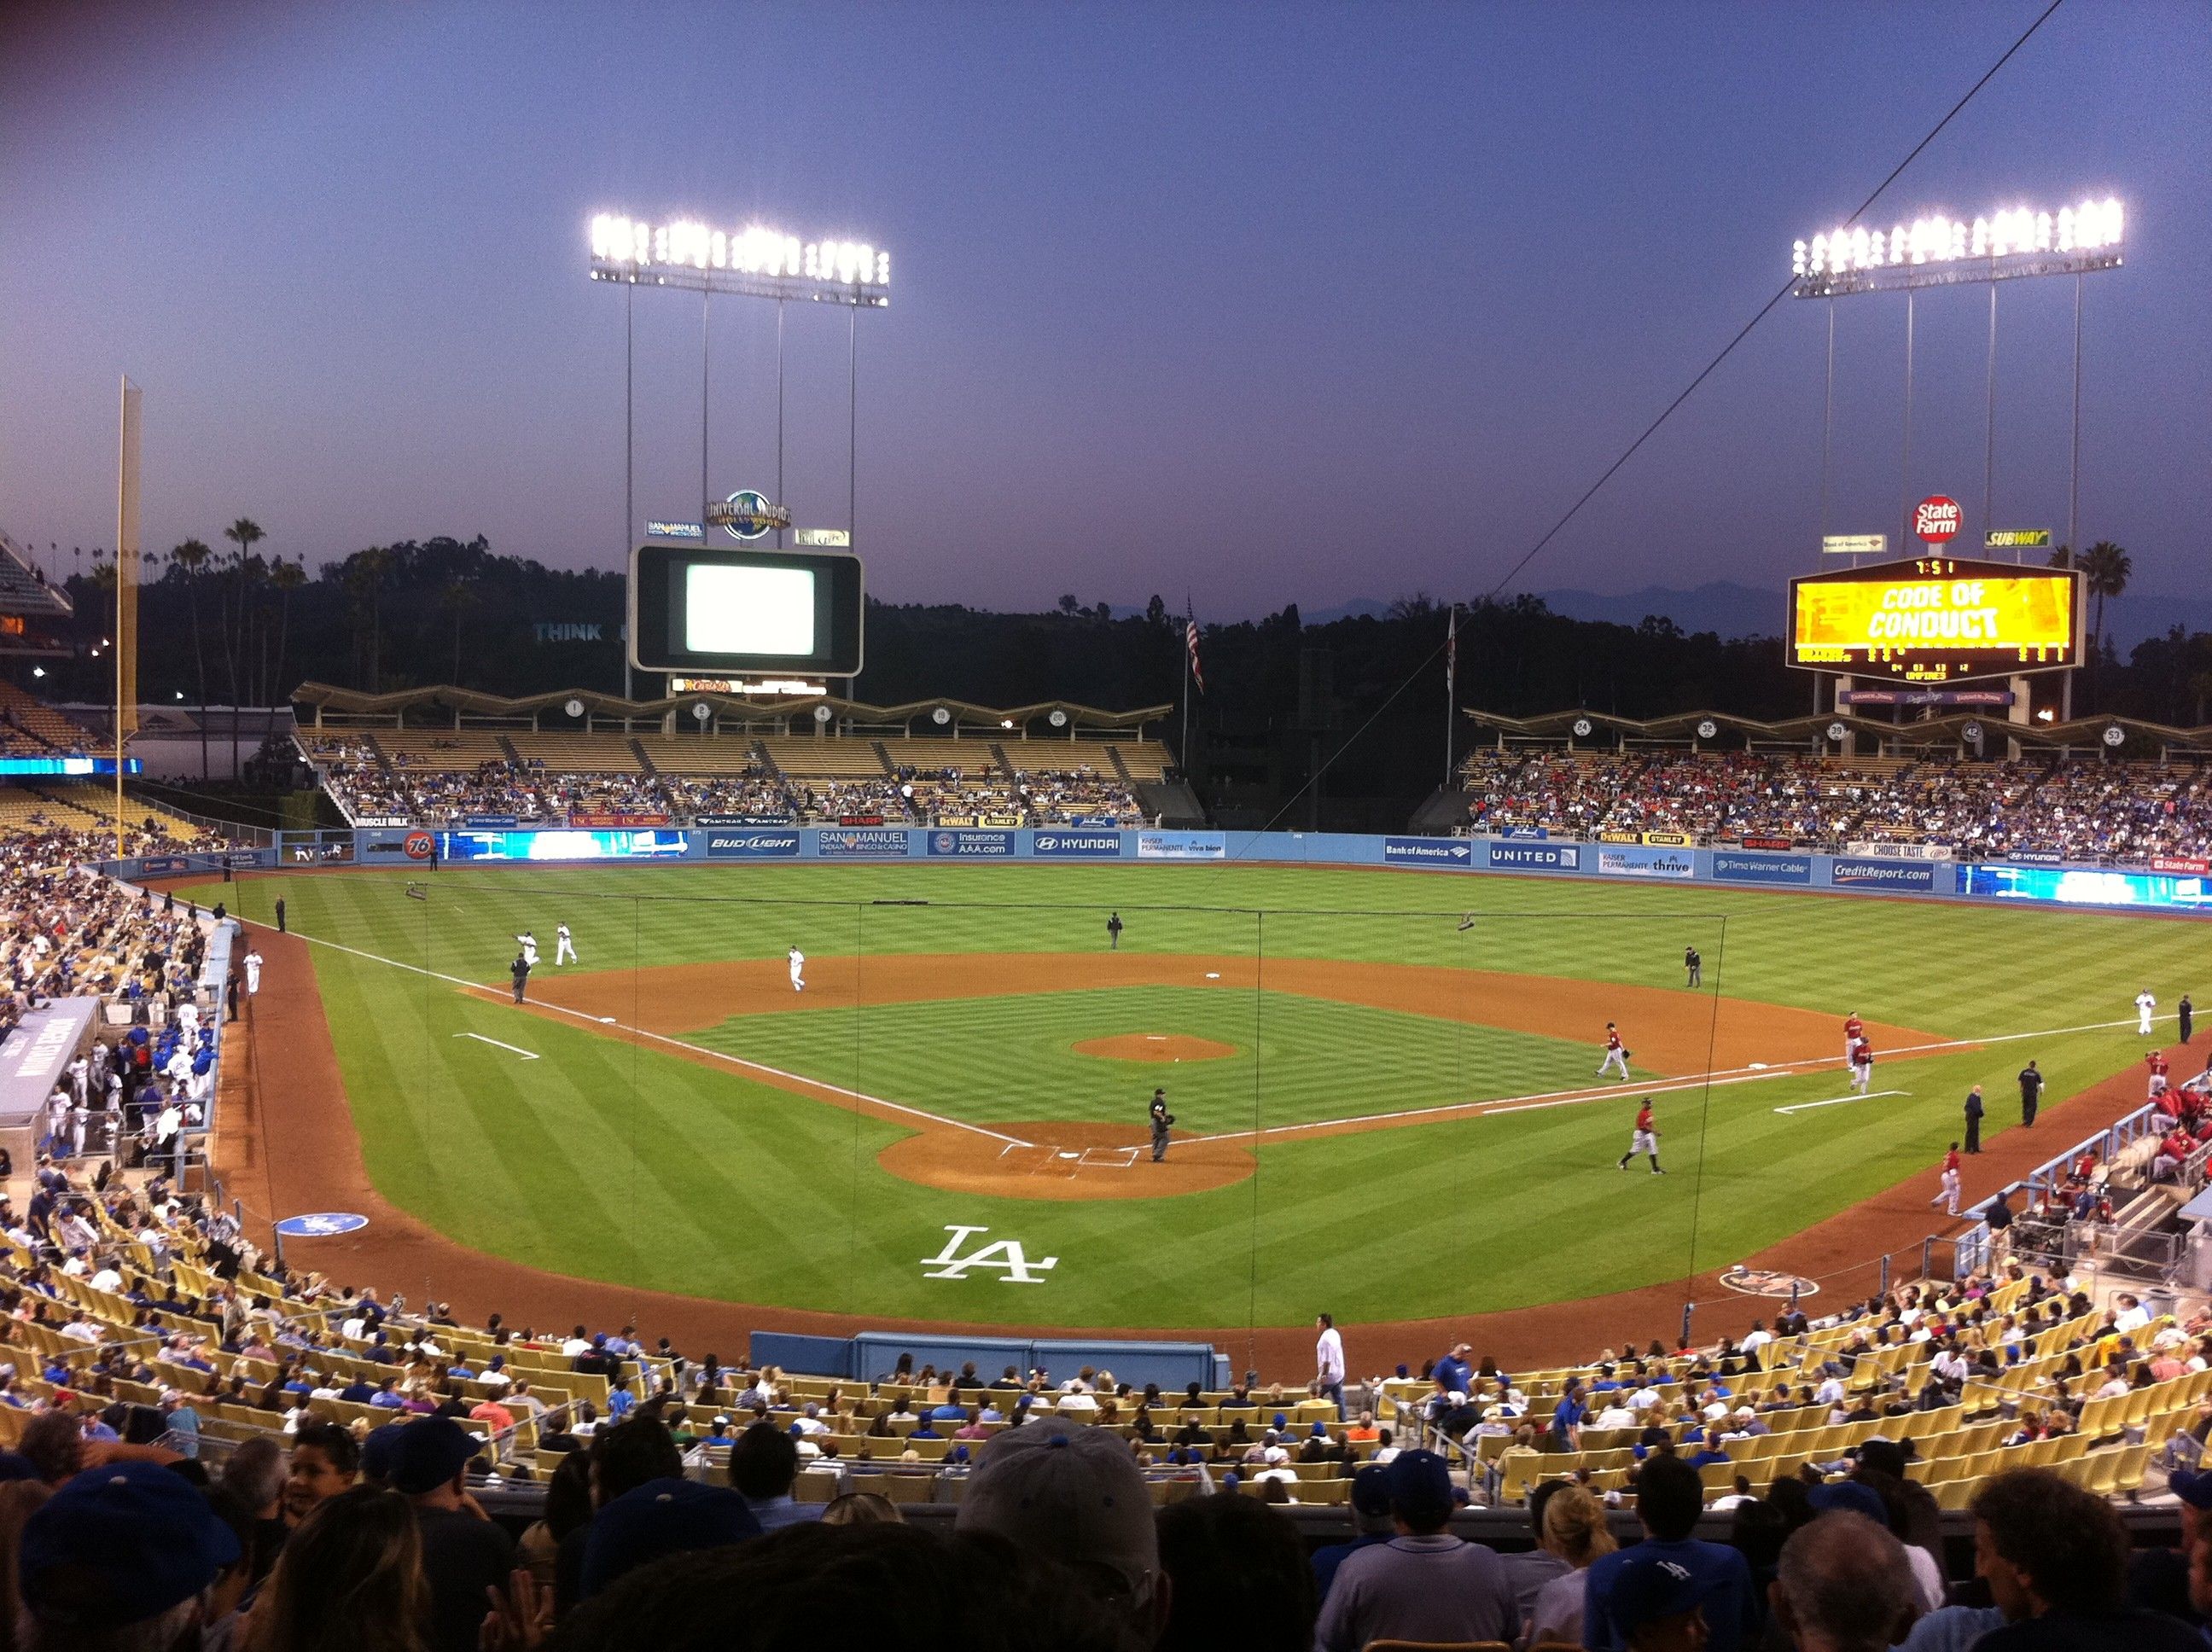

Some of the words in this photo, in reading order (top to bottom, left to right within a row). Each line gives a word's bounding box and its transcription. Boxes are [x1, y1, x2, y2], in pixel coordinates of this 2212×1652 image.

[1917, 503, 1958, 519] State
[1917, 519, 1957, 534] Farm
[1986, 531, 2048, 547] SUBWAY
[1882, 585, 1943, 609] CODE
[1951, 582, 1986, 606] OF
[1867, 608, 1999, 638] CONDUCT
[533, 623, 602, 641] THINK
[356, 817, 387, 827] MUSCLE
[388, 817, 408, 827] MILK
[841, 817, 882, 825] SHARP
[711, 839, 746, 848] BUD
[751, 839, 796, 848] LIGHT
[820, 832, 847, 843] SAN
[856, 832, 907, 843] MANUEL
[958, 833, 1005, 842] Insurance
[1743, 839, 1790, 847] SHARP
[409, 836, 431, 853] 76
[958, 844, 1005, 853] AAA.com
[1061, 839, 1119, 849] HYUNDAI
[1873, 844, 1901, 856] CHOOSE
[1386, 845, 1406, 855] Bank
[1406, 846, 1415, 855] of
[1416, 846, 1449, 857] America
[1492, 850, 1557, 863] UNITED
[1603, 861, 1649, 870] PERMANENTE
[1653, 858, 1690, 871] thrive
[1728, 860, 1748, 870] Time
[1749, 861, 1779, 871] Warner
[1780, 863, 1805, 873] Cable
[2163, 860, 2183, 870] State
[2184, 861, 2205, 871] Farm
[1835, 864, 1930, 881] CreditReport.com
[919, 1224, 1059, 1283] LA
